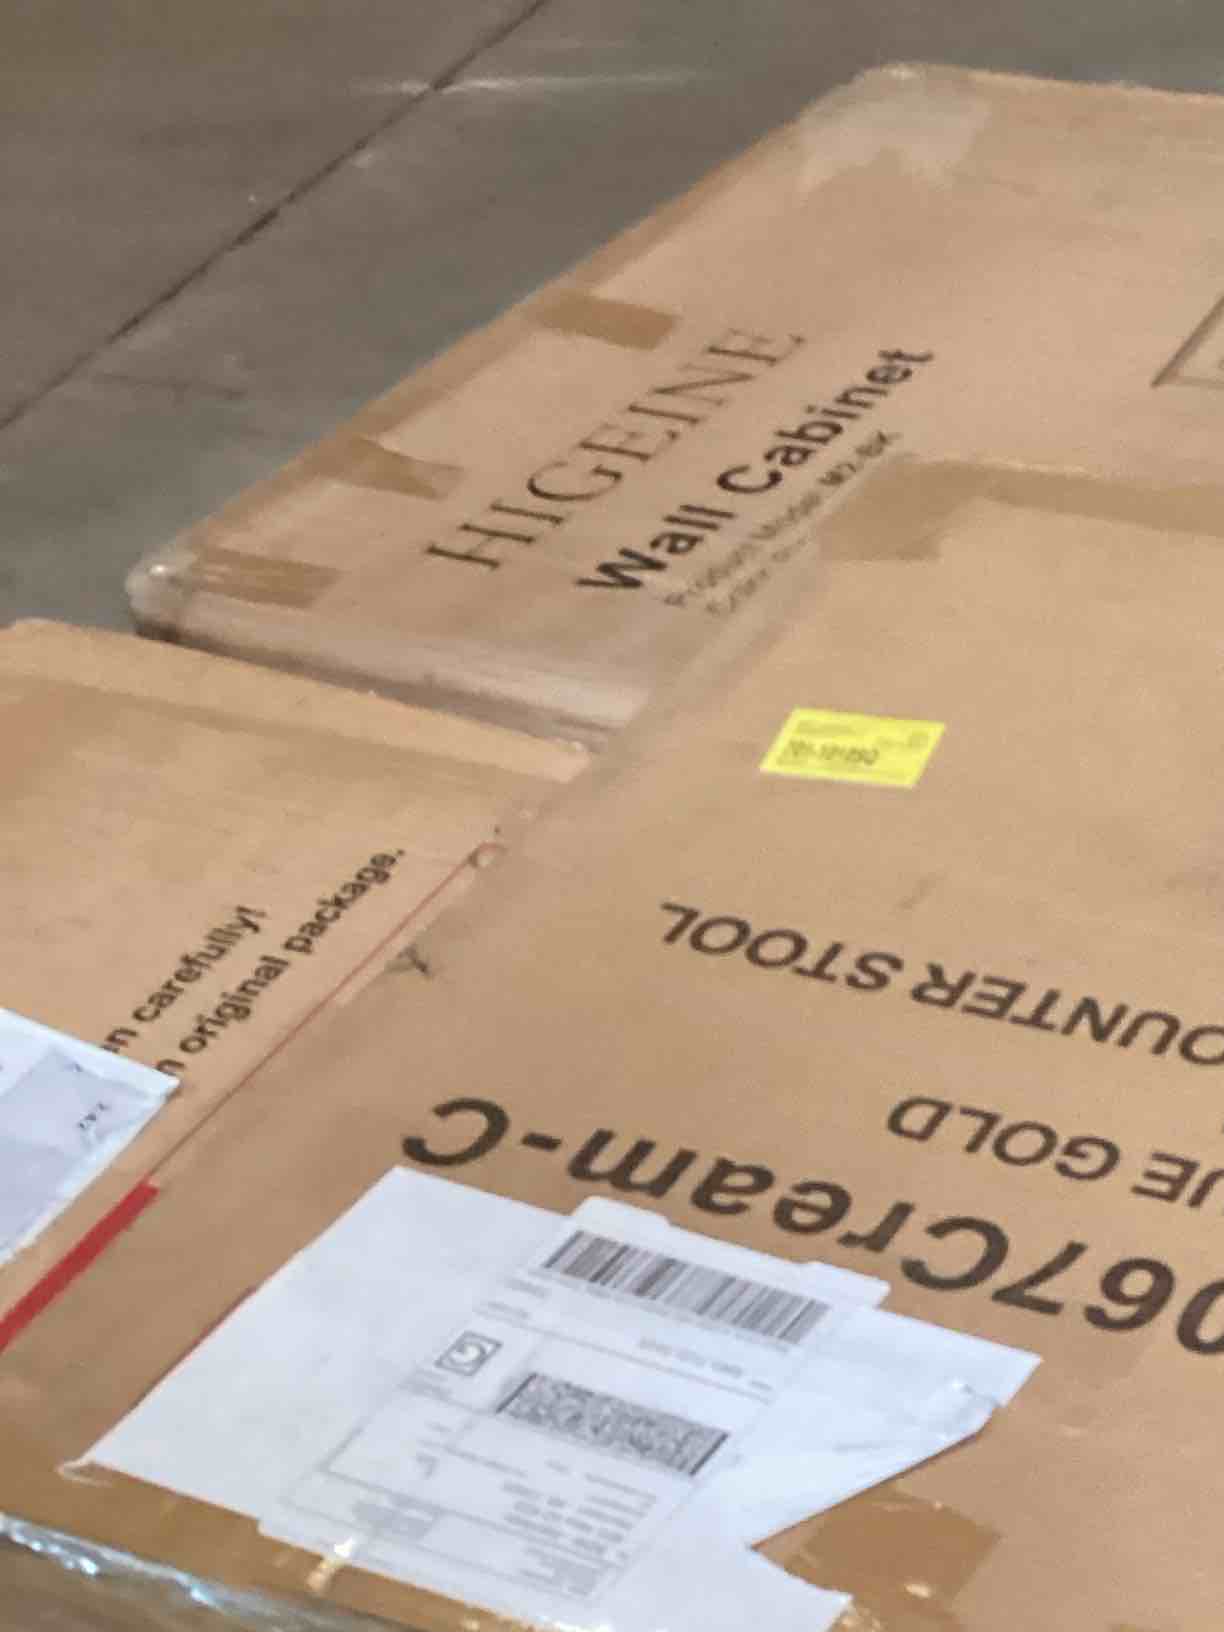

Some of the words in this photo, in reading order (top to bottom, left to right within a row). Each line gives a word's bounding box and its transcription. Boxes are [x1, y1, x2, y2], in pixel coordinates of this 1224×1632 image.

[425, 326, 806, 572] HIGEINE
[573, 501, 739, 591] Wall
[717, 346, 935, 496] Cabinet
[132, 902, 268, 1023] carefully!
[179, 954, 289, 1056] original
[283, 849, 405, 956] package.
[659, 902, 904, 993] STOOL
[886, 1096, 1122, 1182] GOLD
